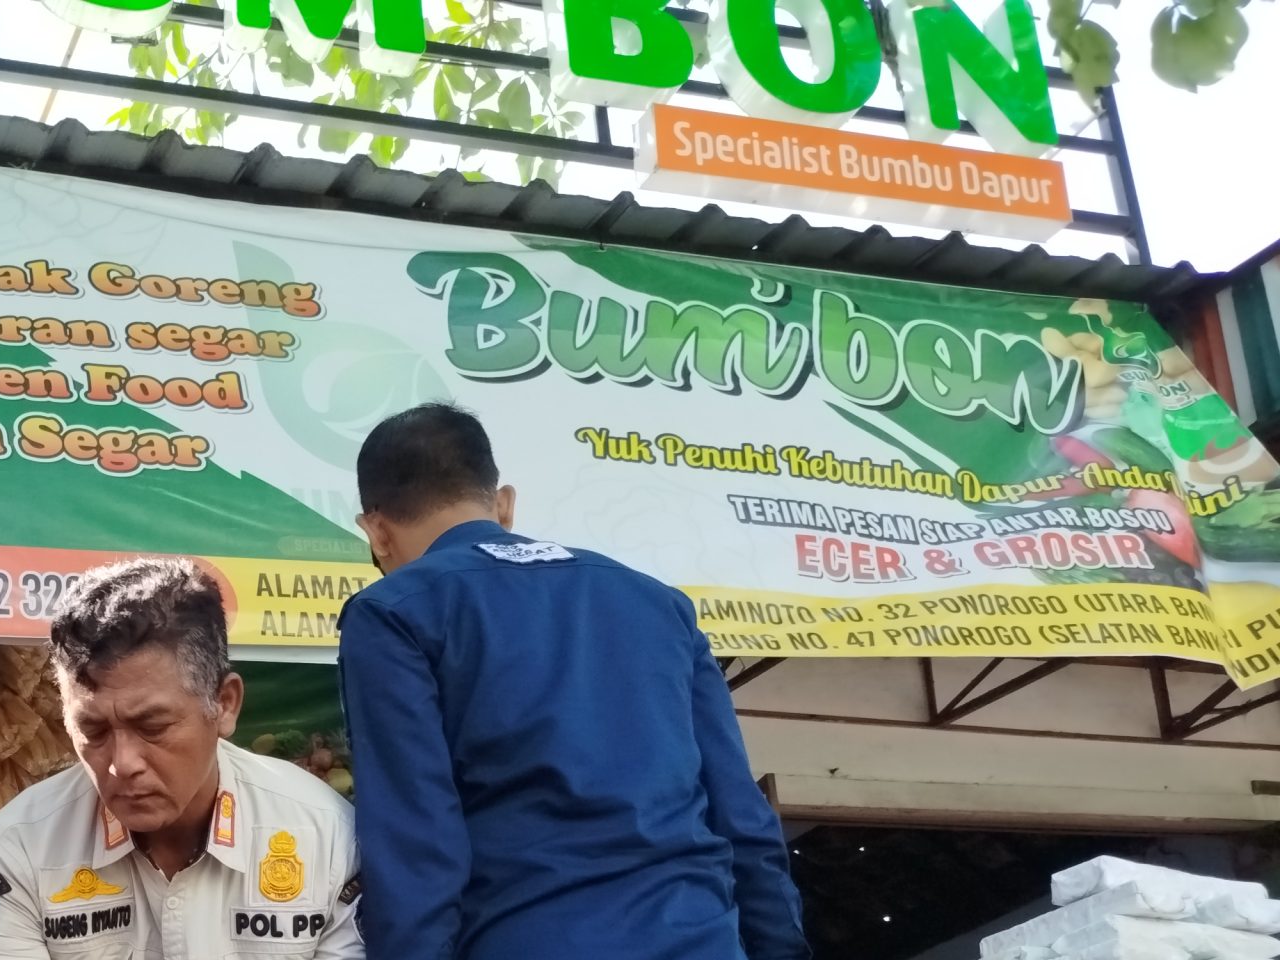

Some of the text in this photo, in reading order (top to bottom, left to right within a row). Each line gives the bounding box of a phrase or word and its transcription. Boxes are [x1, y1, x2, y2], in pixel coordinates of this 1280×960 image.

[671, 121, 1053, 206] Specialist Bumbu Dapur
[90, 262, 322, 317] Goreng
[125, 320, 297, 362] segar
[83, 363, 248, 411] Food
[17, 415, 210, 473] Segar
[575, 427, 657, 465] Yuk
[655, 433, 781, 475] Penuhi
[780, 446, 953, 499] Kebutuhan
[957, 470, 1067, 504] Dapur
[1075, 462, 1170, 493] Anda
[728, 494, 837, 532] TERIMA
[833, 506, 920, 545] PESAN
[919, 518, 989, 546] SIAP
[794, 531, 1155, 584] ECER & GROSIR
[21, 573, 80, 617] 32
[877, 603, 918, 621] 32
[919, 593, 1068, 617] PONOROGO
[1074, 592, 1170, 615] (UTARA
[1169, 596, 1215, 624] BAN
[846, 630, 876, 648] 47
[882, 625, 1033, 647] PONOROGO
[1037, 623, 1165, 645] (SELATAN
[235, 913, 326, 939] POL PP
